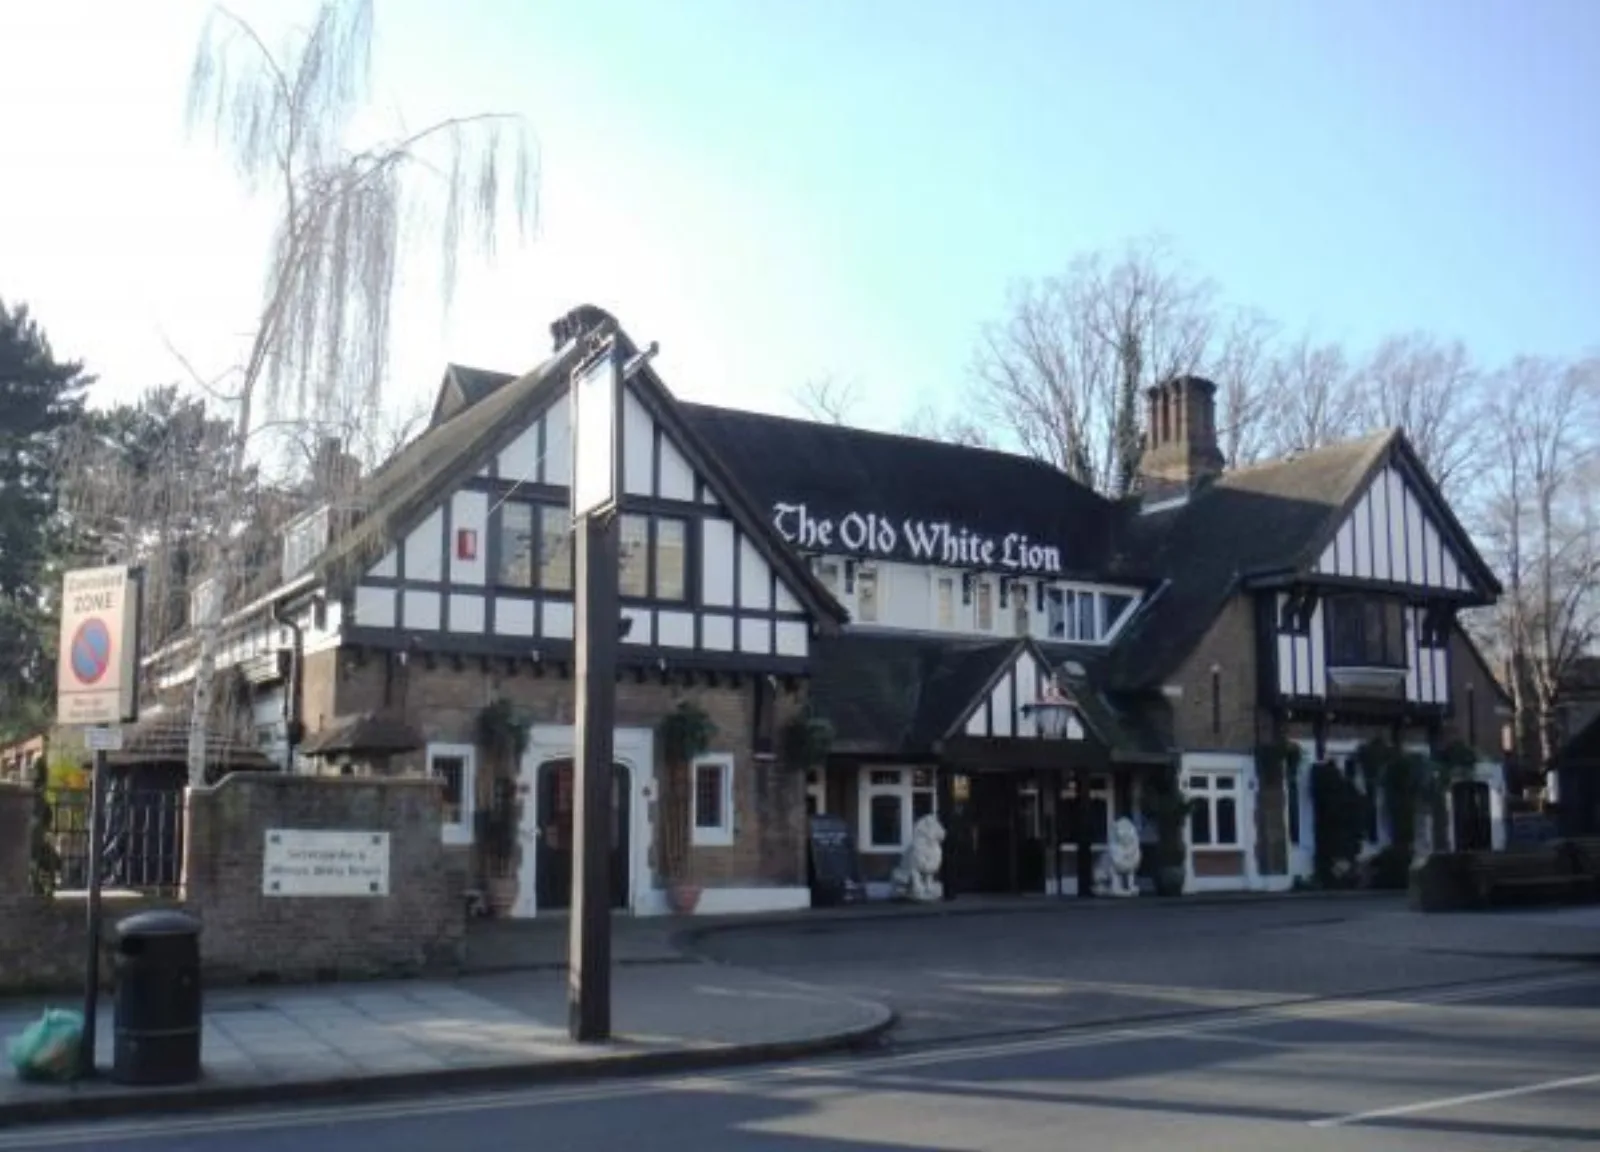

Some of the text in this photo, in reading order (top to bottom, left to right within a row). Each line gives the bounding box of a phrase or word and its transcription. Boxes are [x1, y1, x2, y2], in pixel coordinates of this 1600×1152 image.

[773, 502, 1061, 572] The Old White Lion
[73, 591, 117, 614] ZONE
